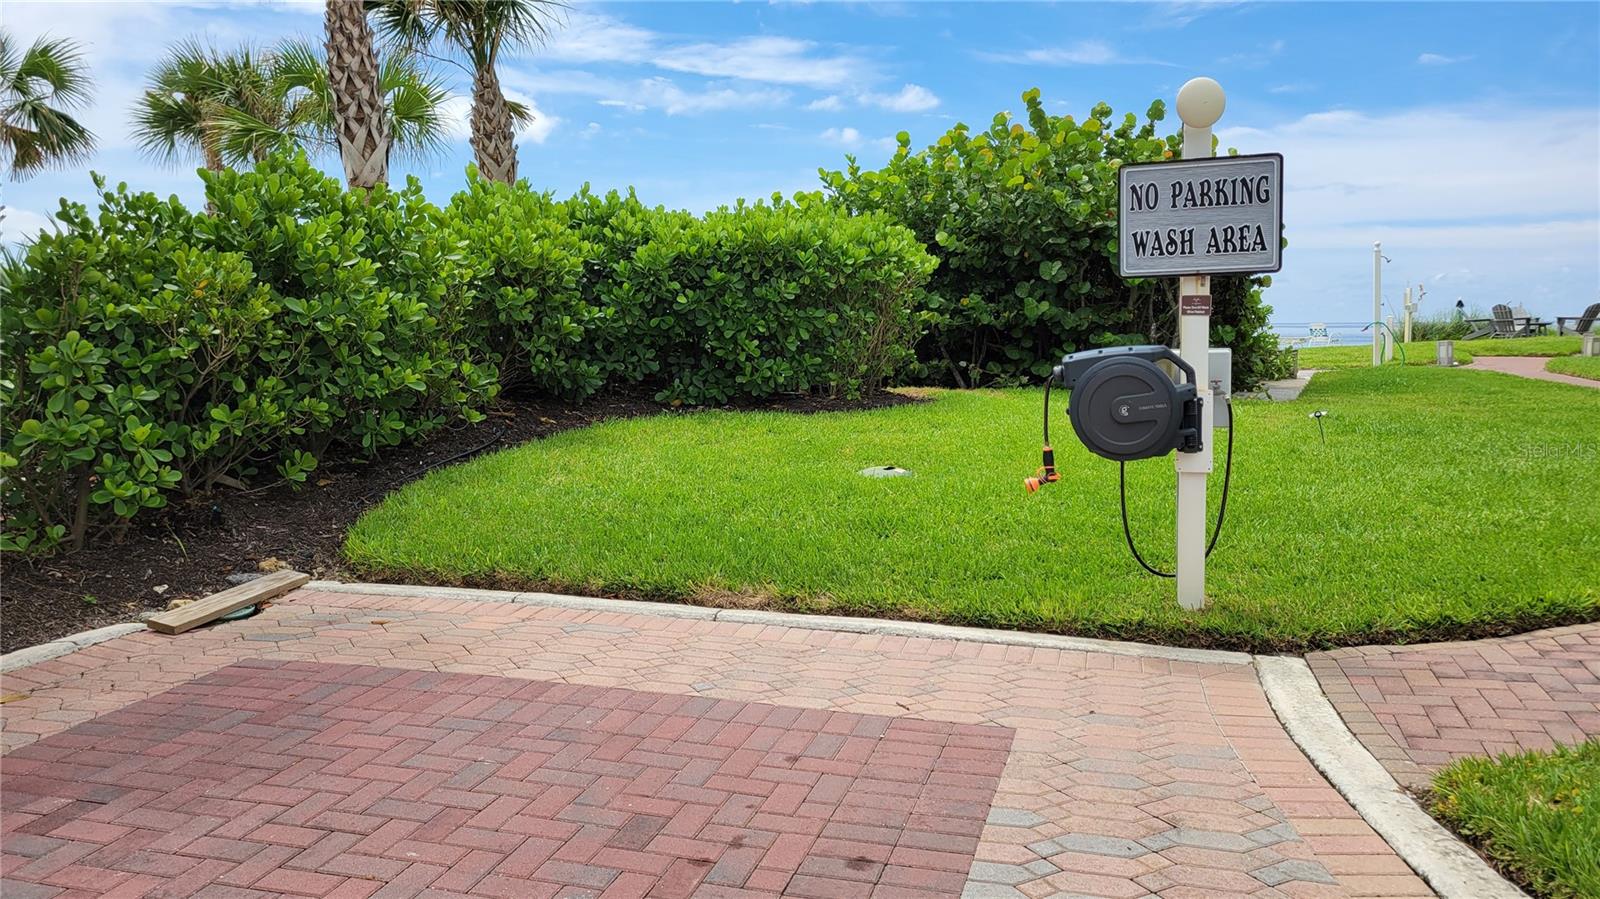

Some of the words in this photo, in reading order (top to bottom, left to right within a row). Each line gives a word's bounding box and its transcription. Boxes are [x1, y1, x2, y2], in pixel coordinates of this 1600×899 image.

[1129, 183, 1159, 211] NO
[1170, 175, 1270, 209] PARKING
[1131, 227, 1195, 258] WASH
[1206, 224, 1267, 254] AREA
